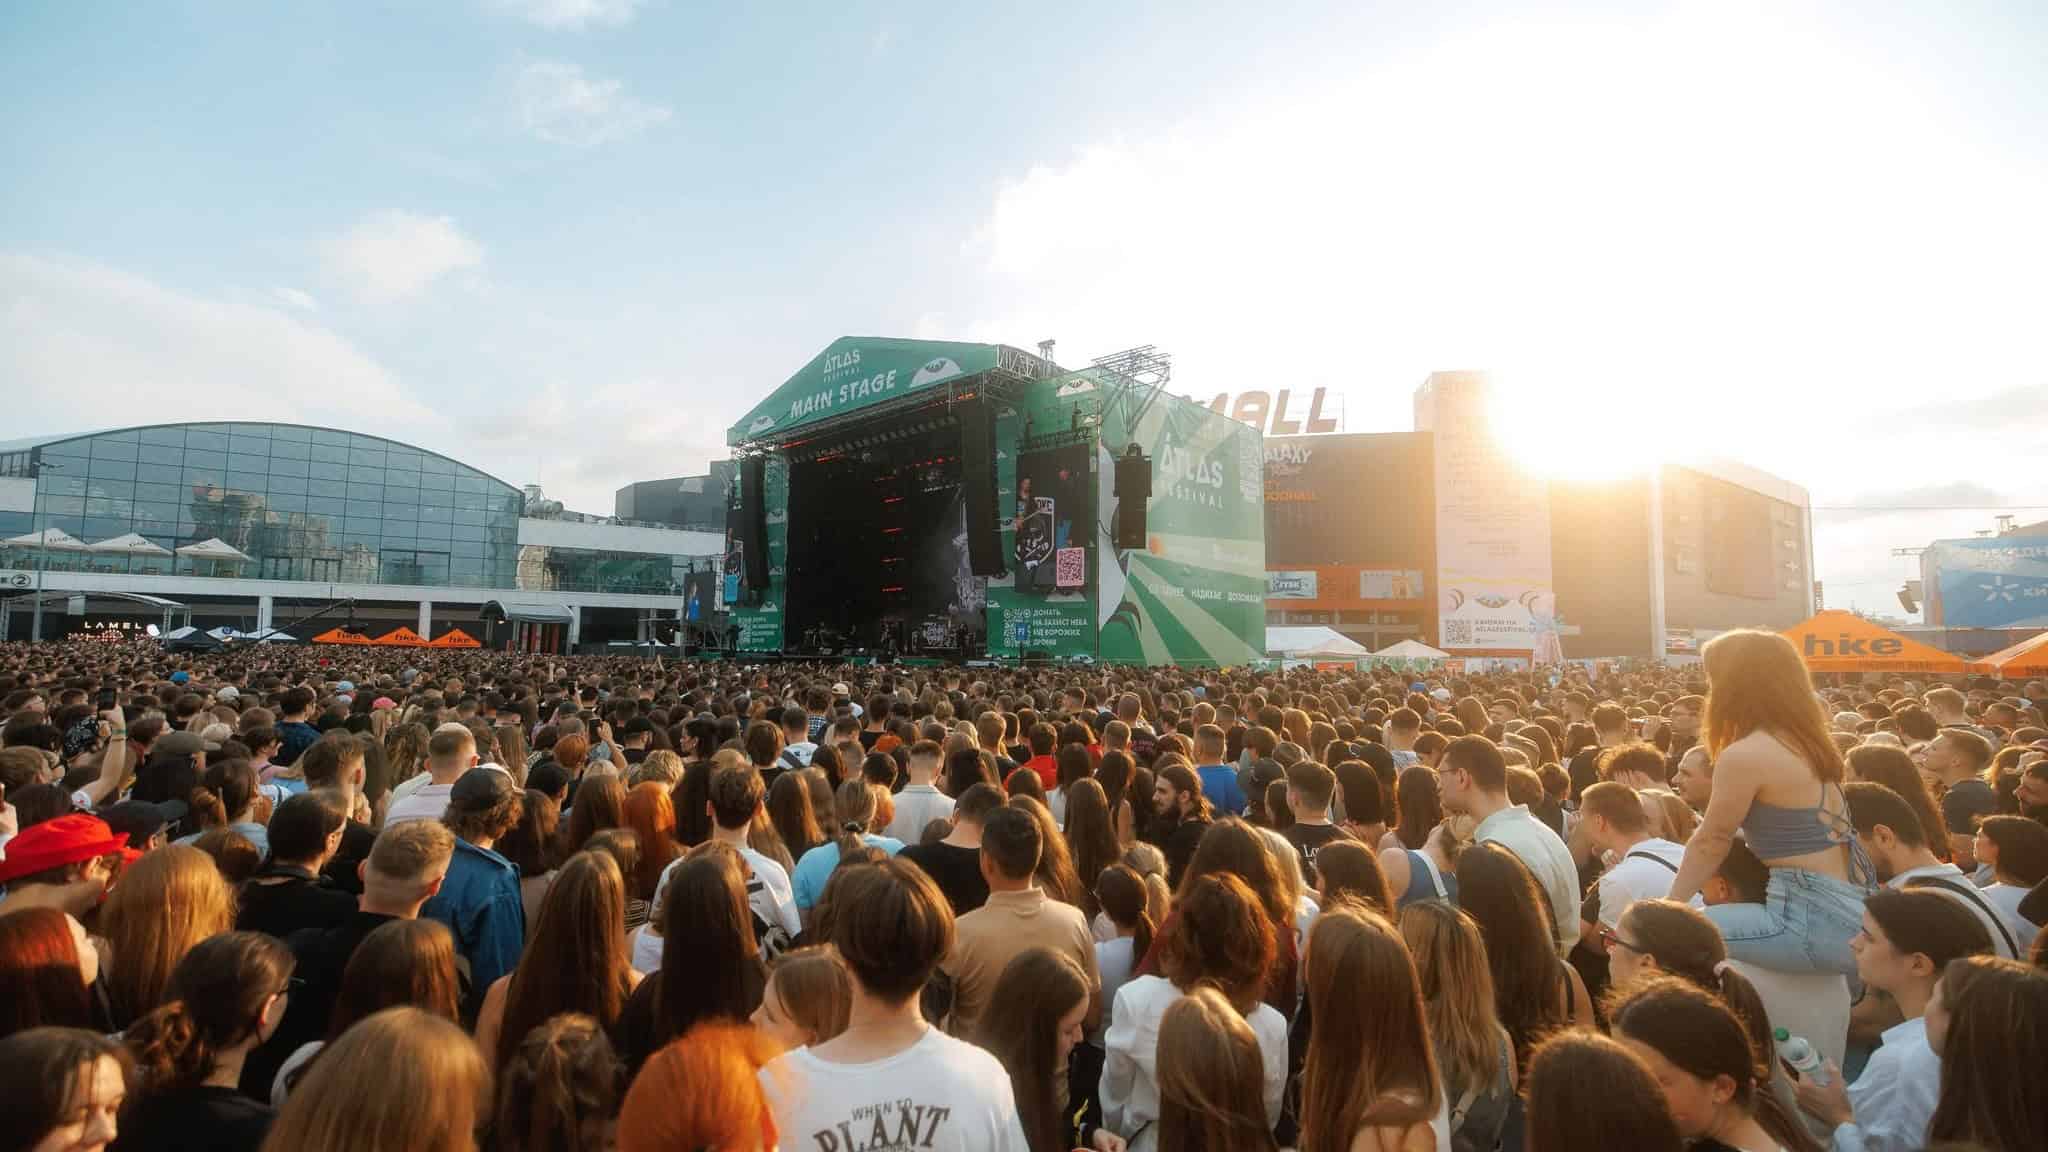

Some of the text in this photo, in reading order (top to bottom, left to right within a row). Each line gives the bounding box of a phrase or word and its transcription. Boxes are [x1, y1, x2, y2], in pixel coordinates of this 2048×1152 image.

[824, 349, 861, 374] ATLAS
[791, 369, 897, 418] MAIN STAGE
[1160, 432, 1223, 488] ATLAS
[84, 621, 142, 630] LAMEL
[1804, 633, 1903, 657] hike
[851, 1097, 913, 1121] WHEN TO
[813, 1105, 951, 1152] PLANT
